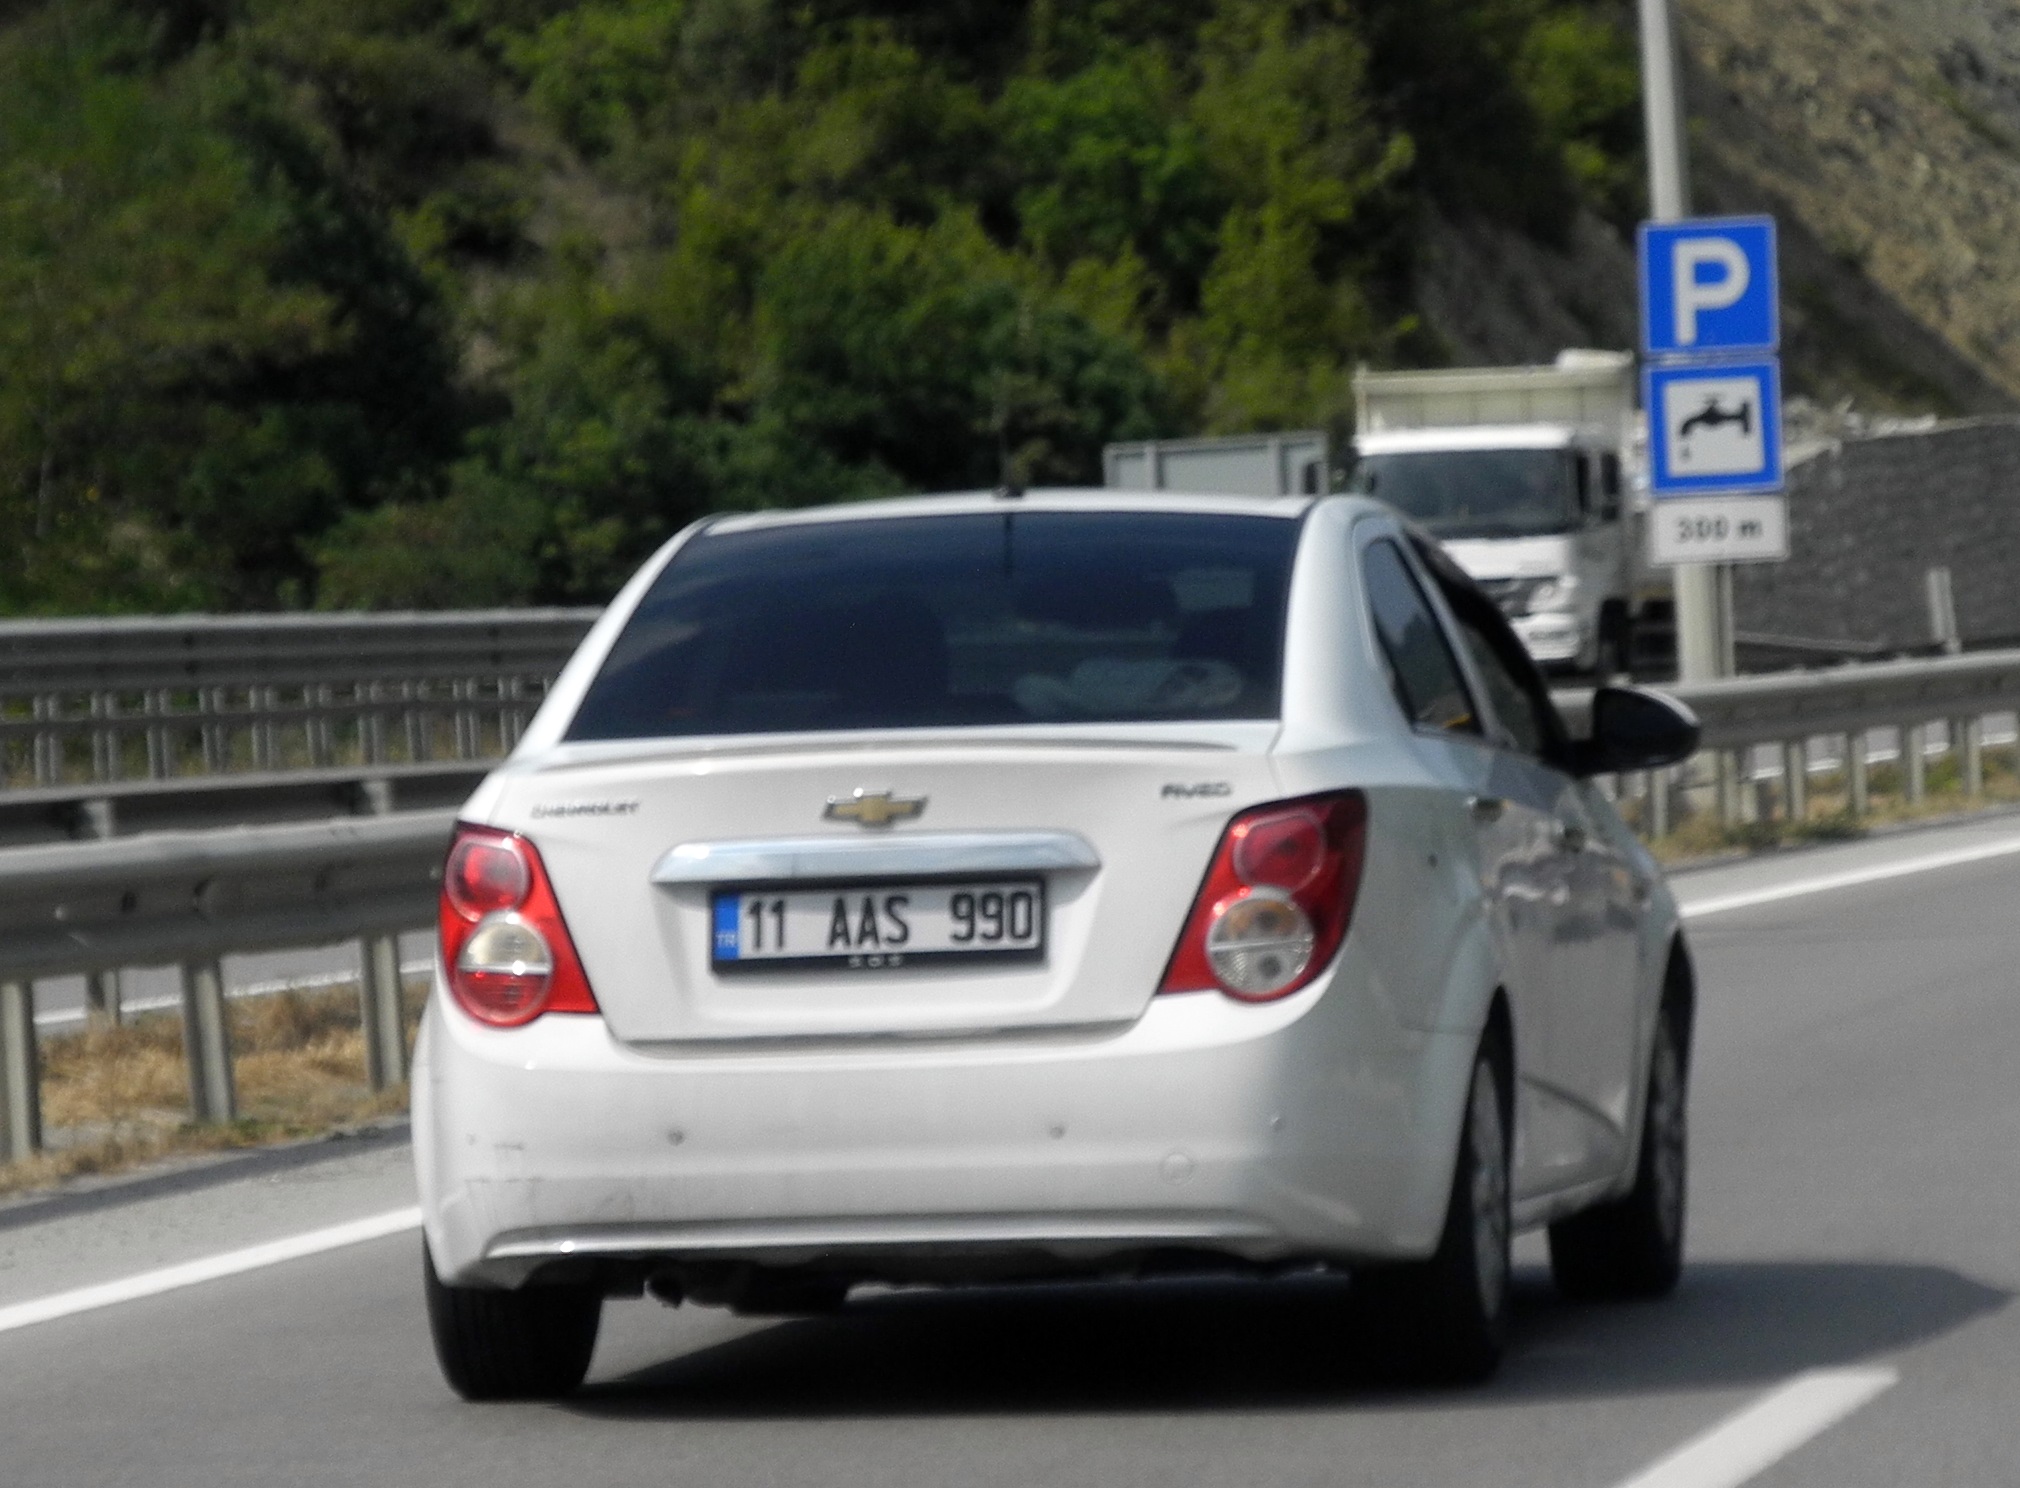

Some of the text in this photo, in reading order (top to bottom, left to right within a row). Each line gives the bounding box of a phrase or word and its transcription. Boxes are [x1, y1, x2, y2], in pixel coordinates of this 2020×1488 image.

[1673, 237, 1750, 345] P
[1676, 515, 1762, 542] 300 m
[749, 892, 1033, 949] 11 AAS 990
